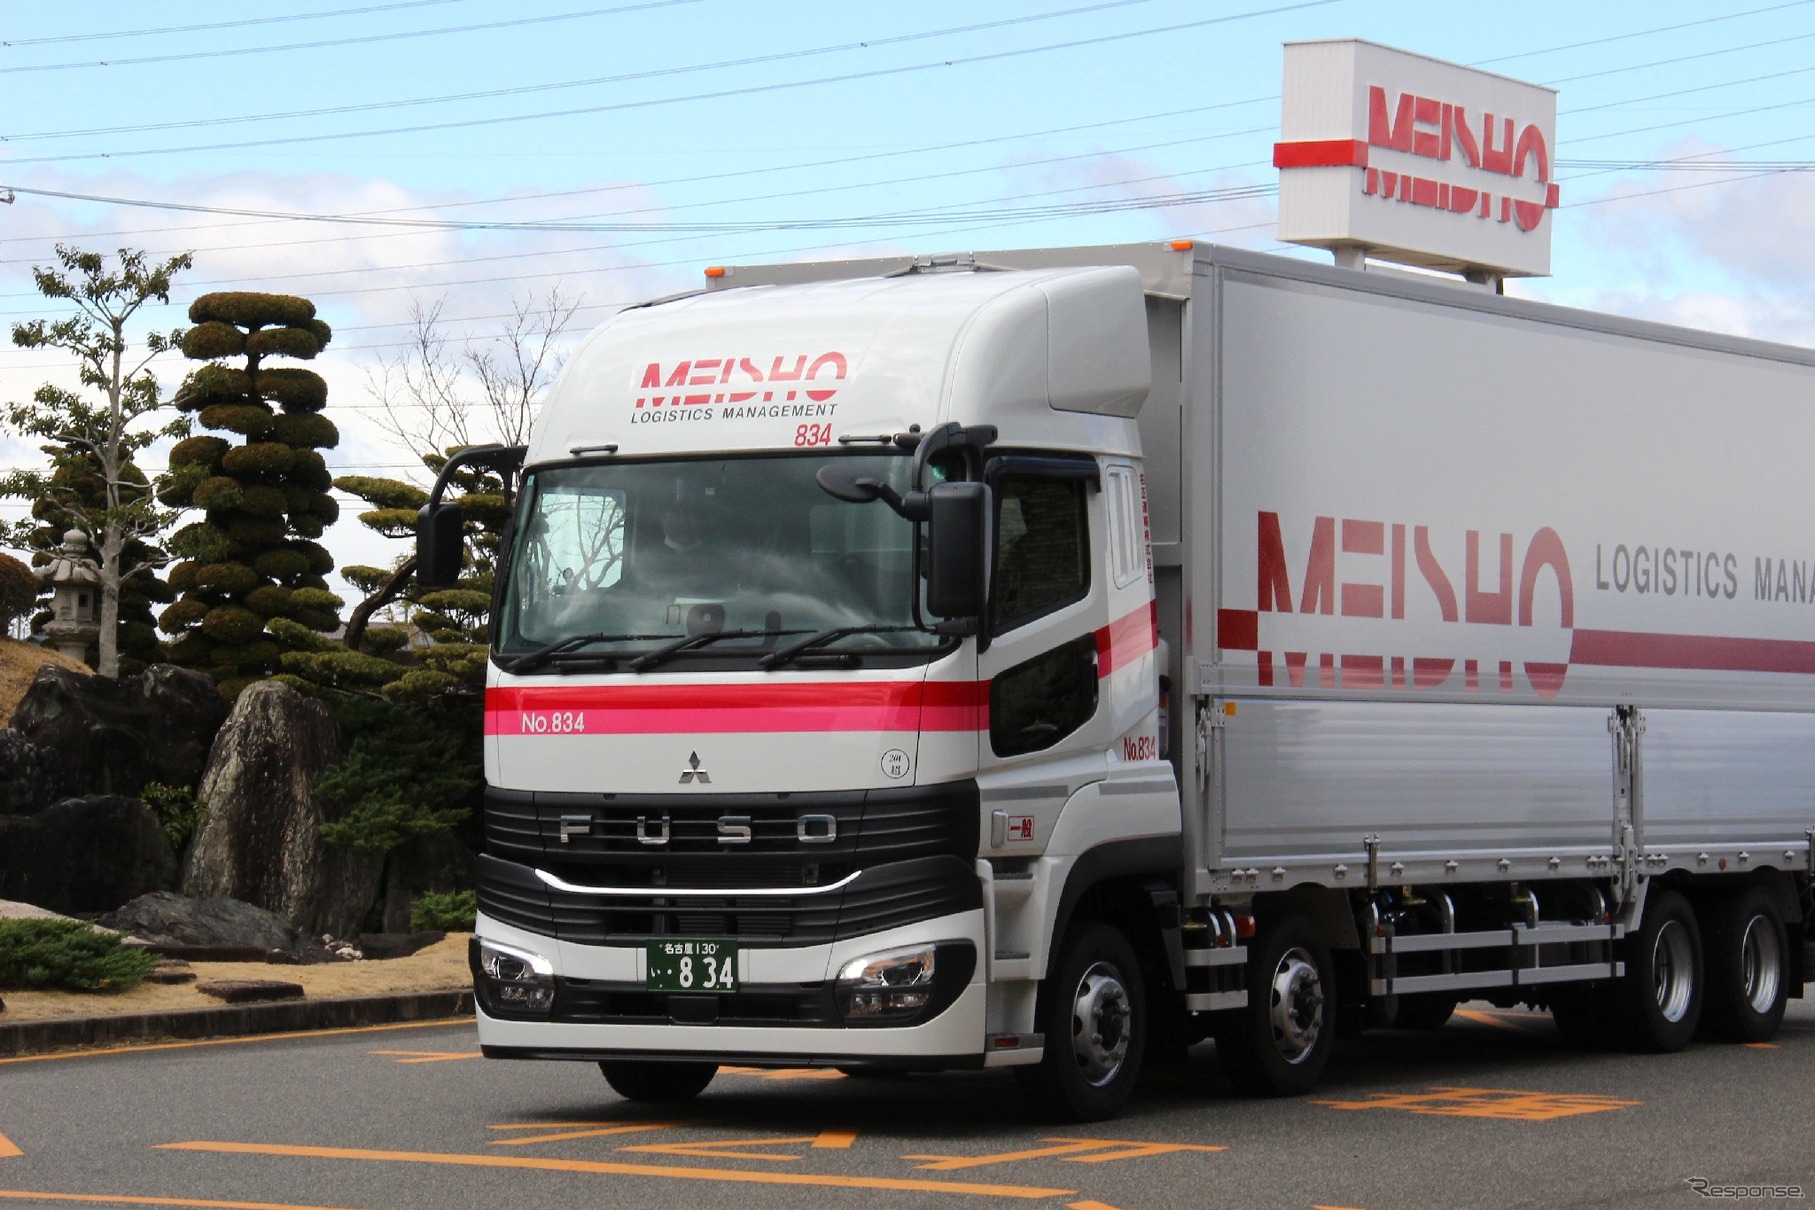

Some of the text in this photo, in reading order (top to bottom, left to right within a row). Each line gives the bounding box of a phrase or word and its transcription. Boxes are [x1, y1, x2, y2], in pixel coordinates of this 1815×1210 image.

[1365, 85, 1549, 232] MEISHO
[635, 351, 848, 408] MEISHO
[631, 402, 838, 424] LOGISTICS MANAGEMENT
[794, 423, 832, 447] 834
[1595, 543, 1738, 600] LOGISTICS
[1257, 510, 1575, 701] MEISHO
[521, 711, 585, 733] No.834
[1123, 736, 1157, 761] No.834
[560, 814, 837, 844] FUSO
[1009, 818, 1033, 838] 一般
[664, 942, 717, 955] 名古屋 130
